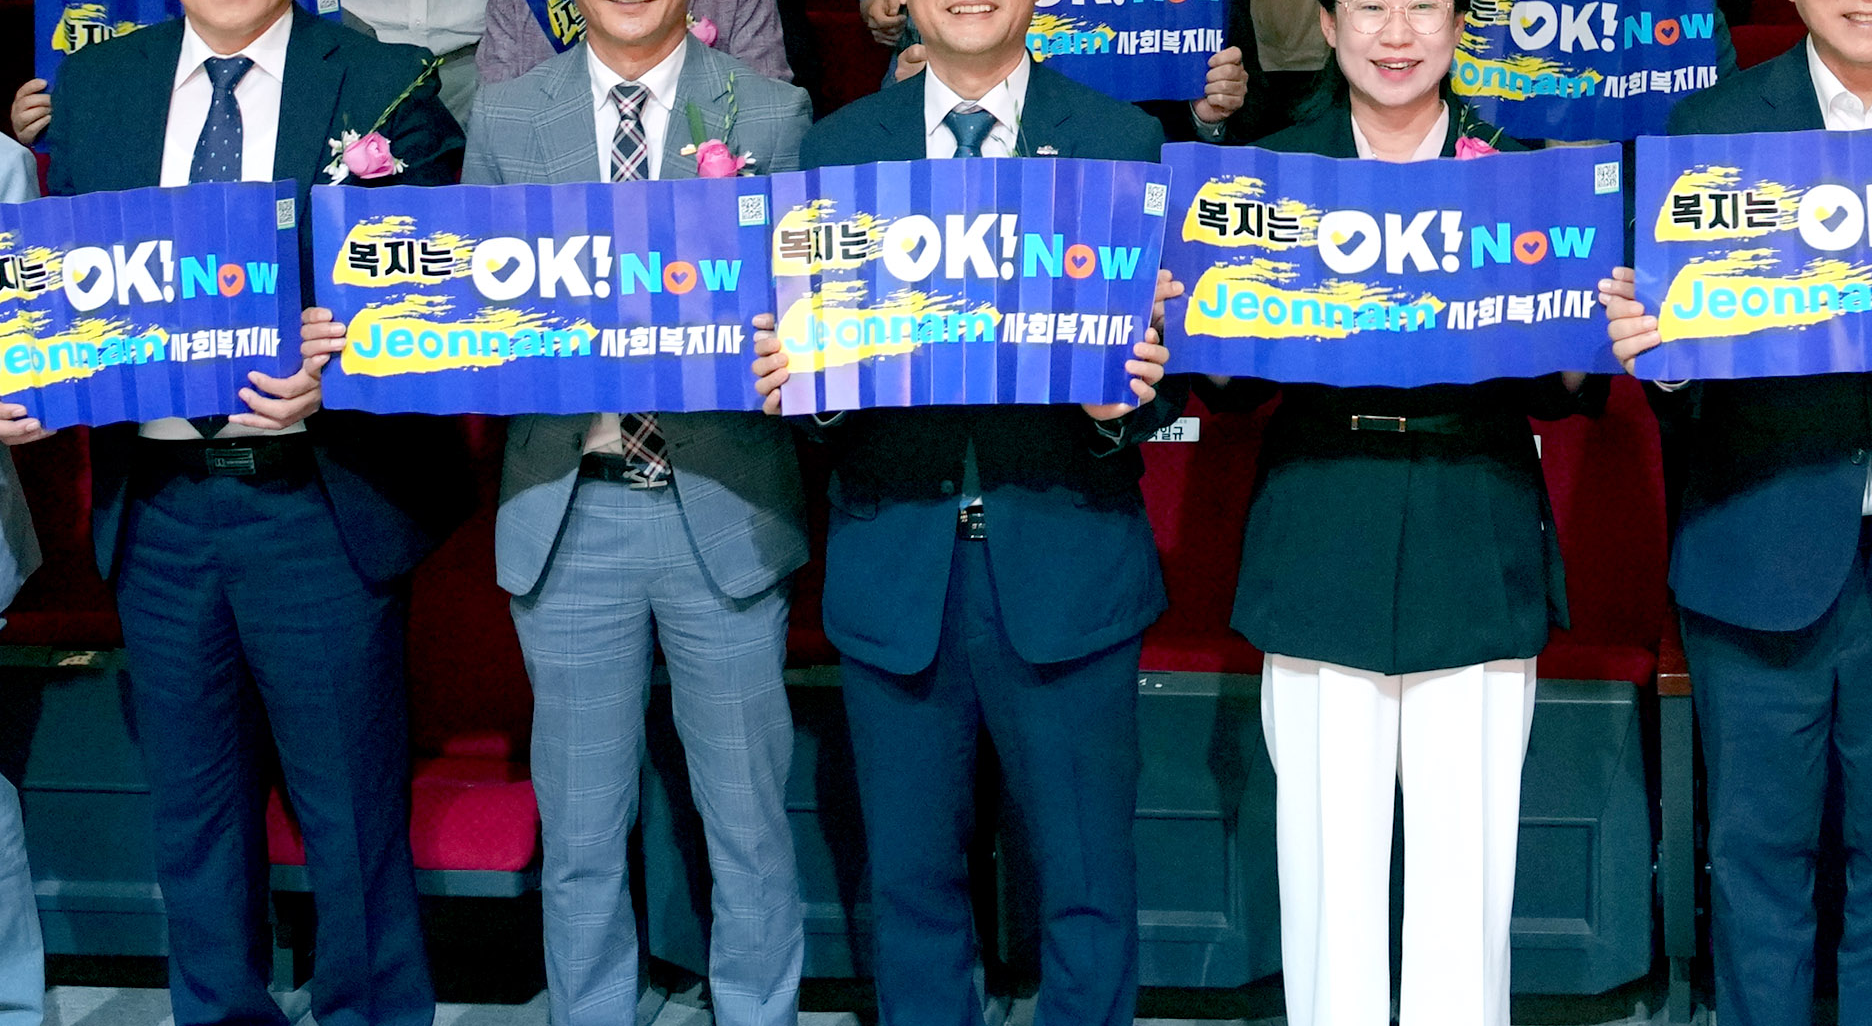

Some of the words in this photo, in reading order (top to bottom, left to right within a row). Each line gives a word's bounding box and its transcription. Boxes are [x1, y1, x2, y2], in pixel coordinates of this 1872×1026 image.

[1117, 28, 1223, 55] 사회복지사
[1510, 0, 1618, 54] OK!
[1455, 59, 1596, 99] onnam
[1603, 66, 1718, 99] 사회복지사
[1671, 191, 1778, 230] 복지는
[779, 223, 868, 264] 복지는
[881, 213, 1019, 282] OK!
[1197, 197, 1300, 243] 복지는
[1317, 208, 1464, 274] OK!
[0, 255, 48, 292] 지는
[62, 240, 175, 311] OK!
[347, 238, 453, 277] 복지는
[471, 235, 612, 301] OK!
[785, 309, 996, 352] Jeonnam
[1002, 312, 1133, 345] 사회복지사
[1199, 283, 1437, 332] Jeonnam
[1447, 288, 1597, 330] 사회복지사
[4, 333, 165, 374] eonnam
[171, 327, 280, 362] 사회복지사
[352, 323, 591, 360] Jeonnam
[601, 324, 744, 358] 사회복지사
